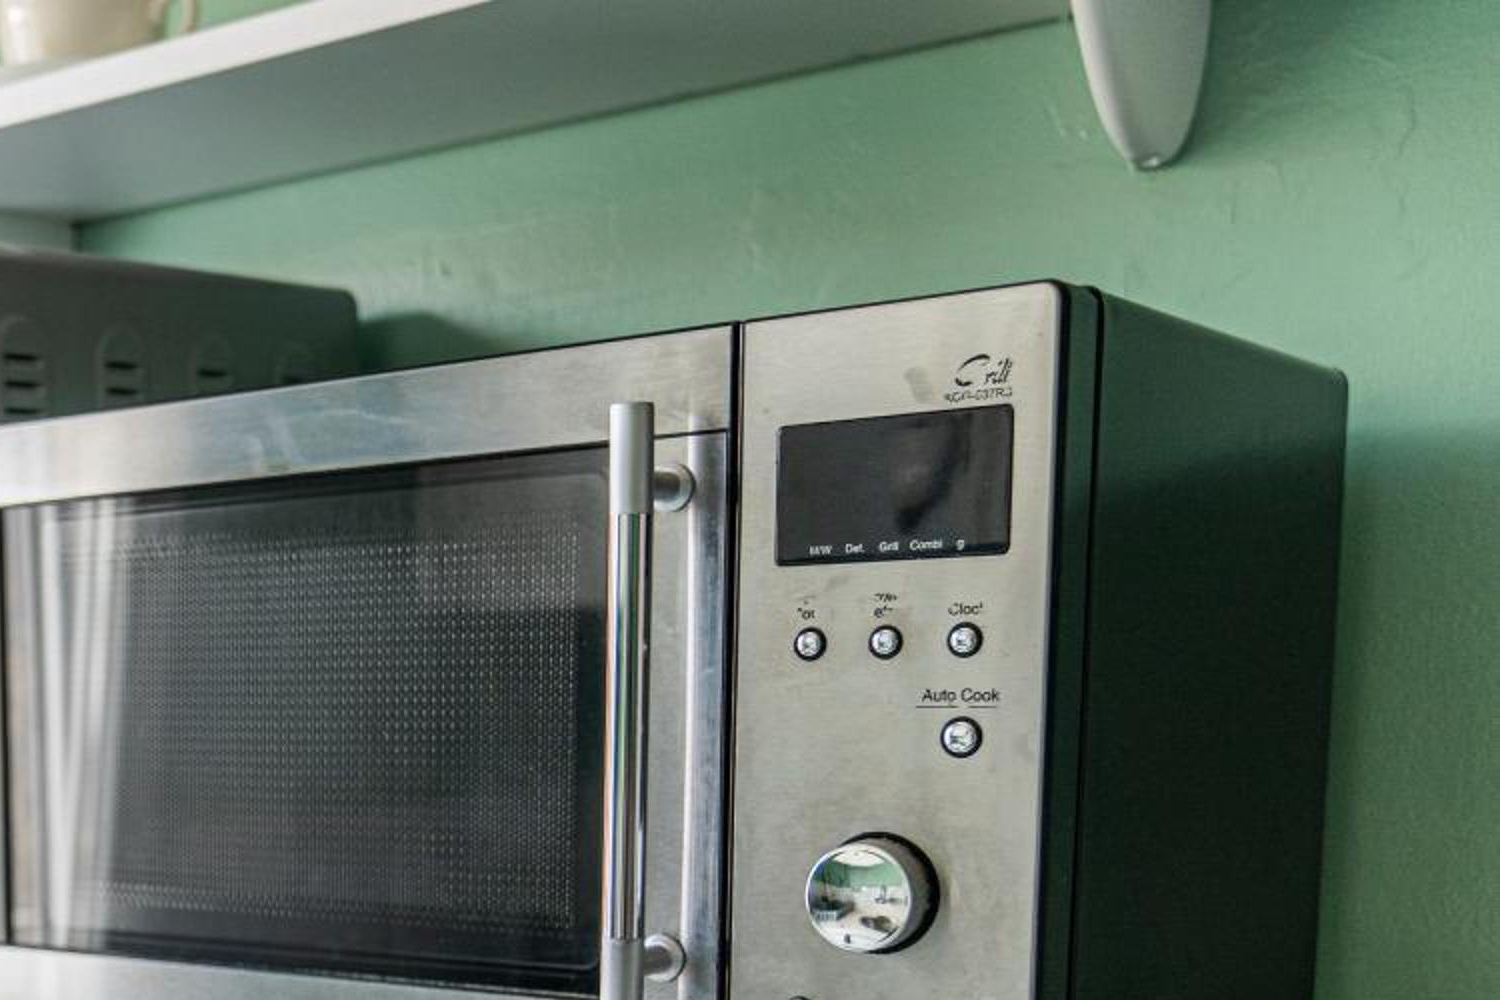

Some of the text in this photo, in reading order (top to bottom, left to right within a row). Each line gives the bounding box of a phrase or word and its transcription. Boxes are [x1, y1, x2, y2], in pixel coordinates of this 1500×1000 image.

[909, 539, 943, 551] Combi
[921, 687, 1000, 702] Auto Cook
